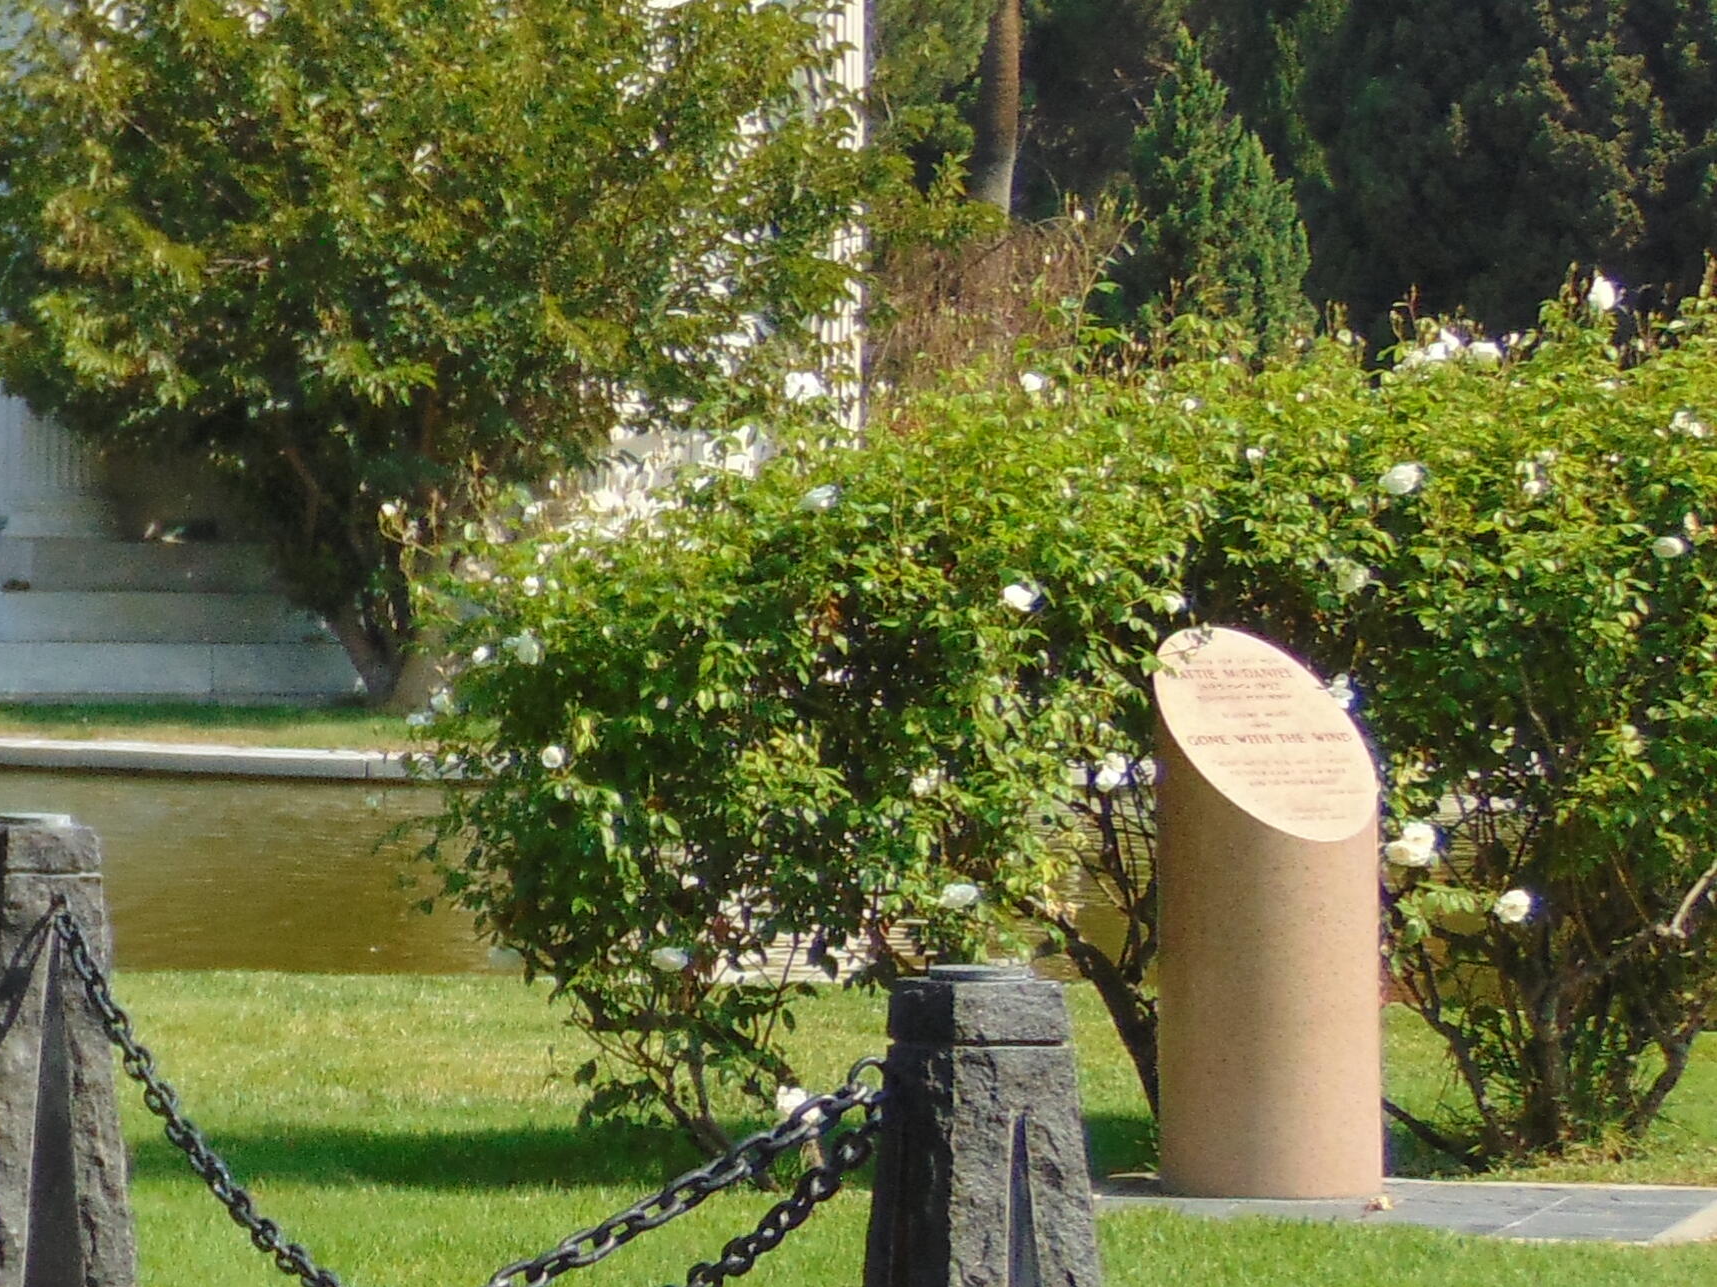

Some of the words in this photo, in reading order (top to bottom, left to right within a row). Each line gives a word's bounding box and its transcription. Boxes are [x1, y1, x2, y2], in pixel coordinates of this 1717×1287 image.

[1187, 735, 1230, 745] GONE
[1234, 734, 1273, 744] WITH
[1277, 733, 1306, 743] THE
[1311, 732, 1353, 742] WIND
